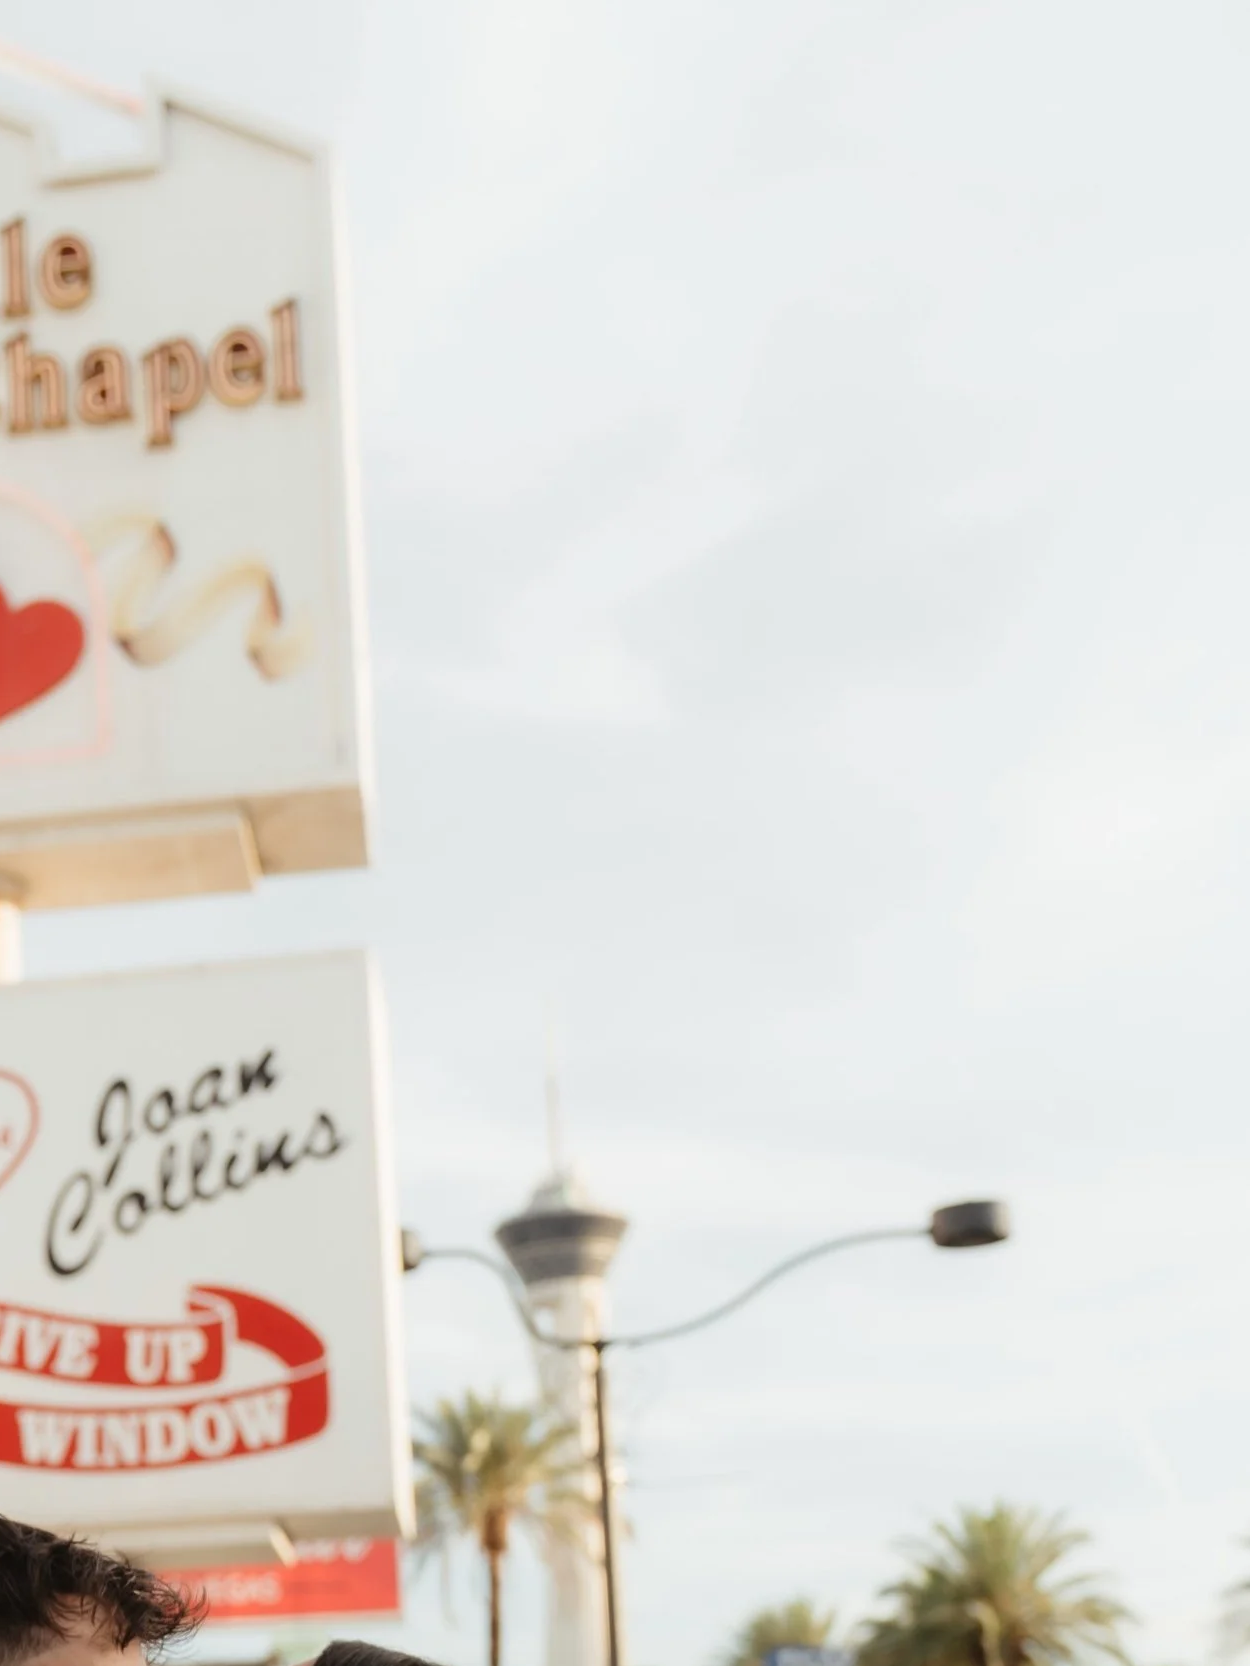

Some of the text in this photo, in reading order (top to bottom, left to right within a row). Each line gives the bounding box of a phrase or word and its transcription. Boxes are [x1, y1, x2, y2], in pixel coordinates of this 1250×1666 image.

[95, 1049, 278, 1188] Joan
[44, 1112, 345, 1280] Collins
[124, 1325, 209, 1385] UP
[16, 1384, 292, 1468] WINDOW
